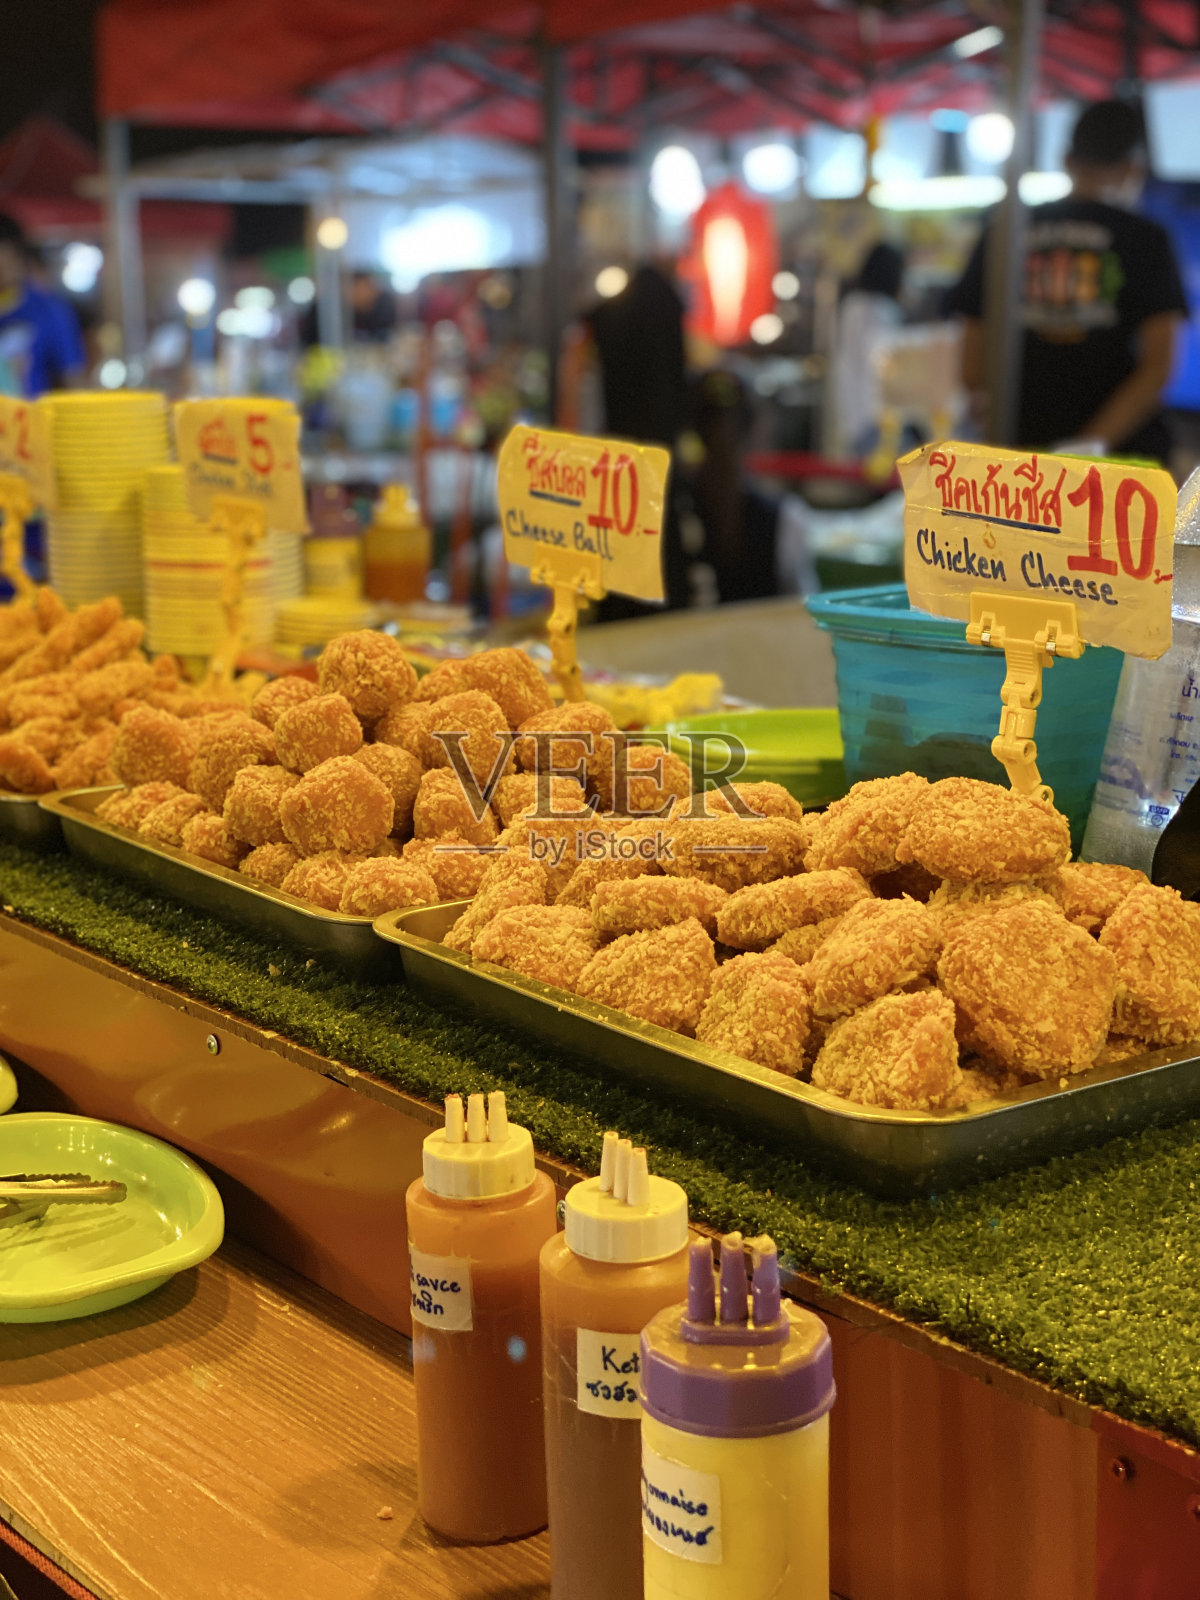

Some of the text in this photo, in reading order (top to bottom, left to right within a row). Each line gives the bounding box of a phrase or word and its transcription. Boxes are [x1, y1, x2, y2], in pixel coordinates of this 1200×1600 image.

[506, 508, 614, 561] Cheese Ball
[916, 528, 1118, 605] Chicken Cheese
[601, 1345, 640, 1374] Ket
